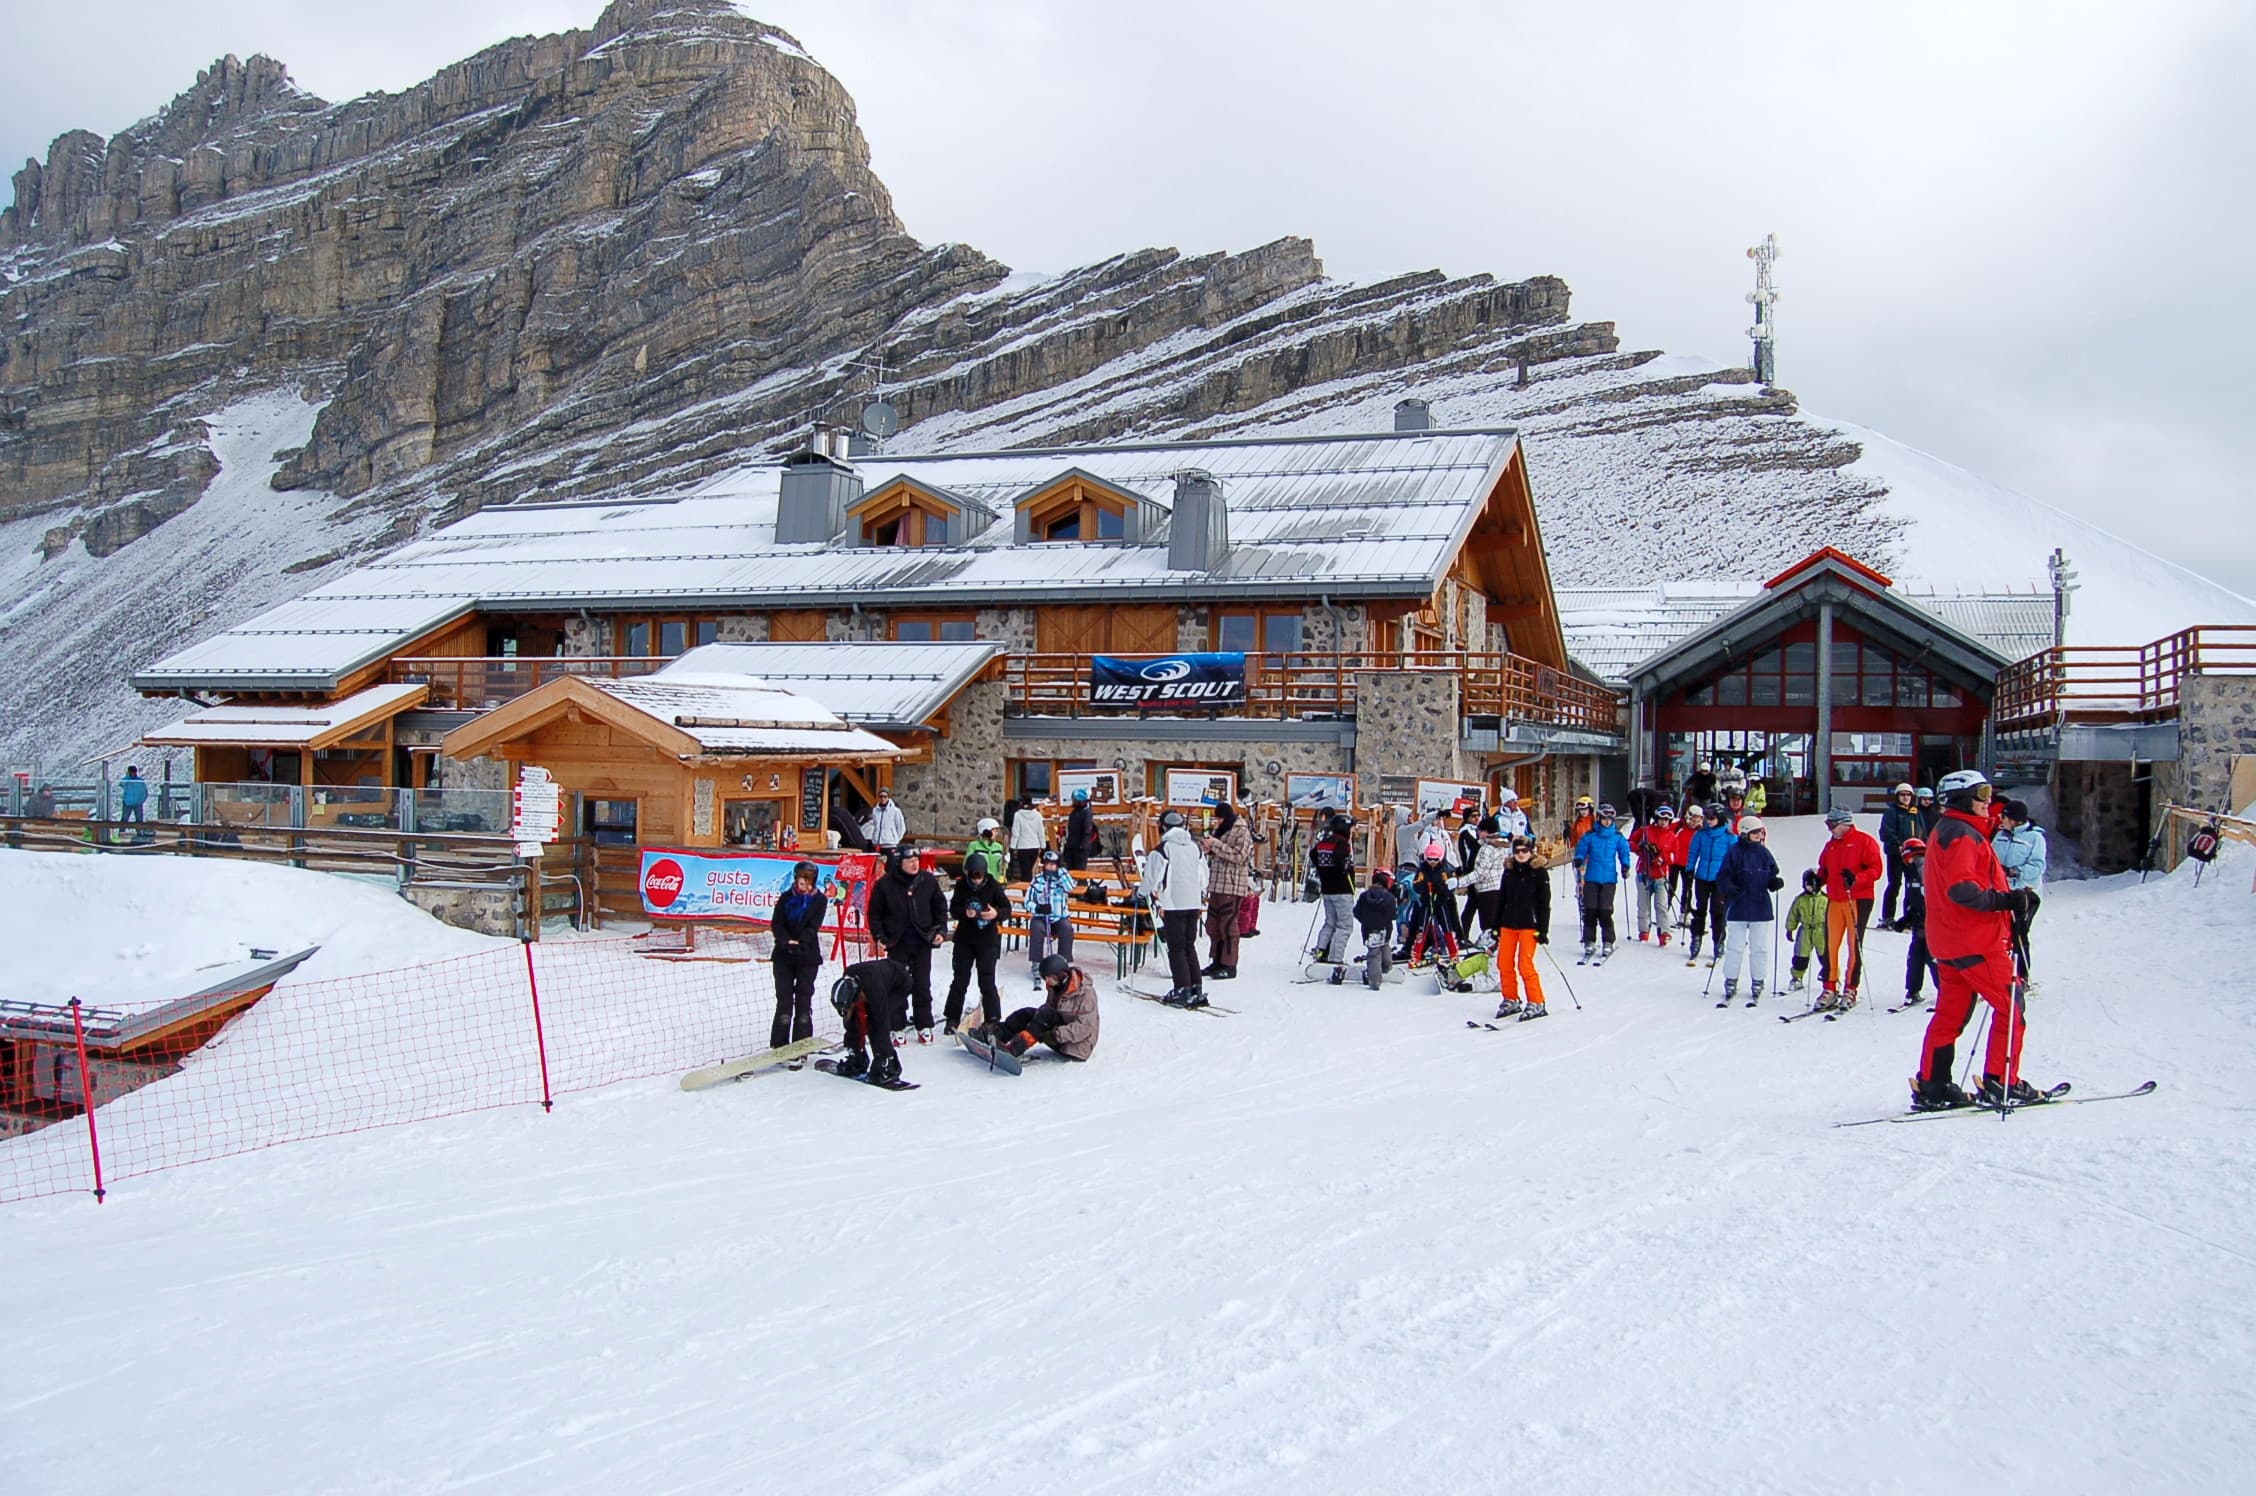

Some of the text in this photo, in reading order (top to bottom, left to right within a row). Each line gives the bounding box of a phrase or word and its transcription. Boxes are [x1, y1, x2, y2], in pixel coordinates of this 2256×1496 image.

[1094, 681, 1239, 700] WEST SCOUT
[646, 874, 682, 891] Coca-Cola
[706, 870, 750, 886] gusta
[711, 888, 724, 904] la
